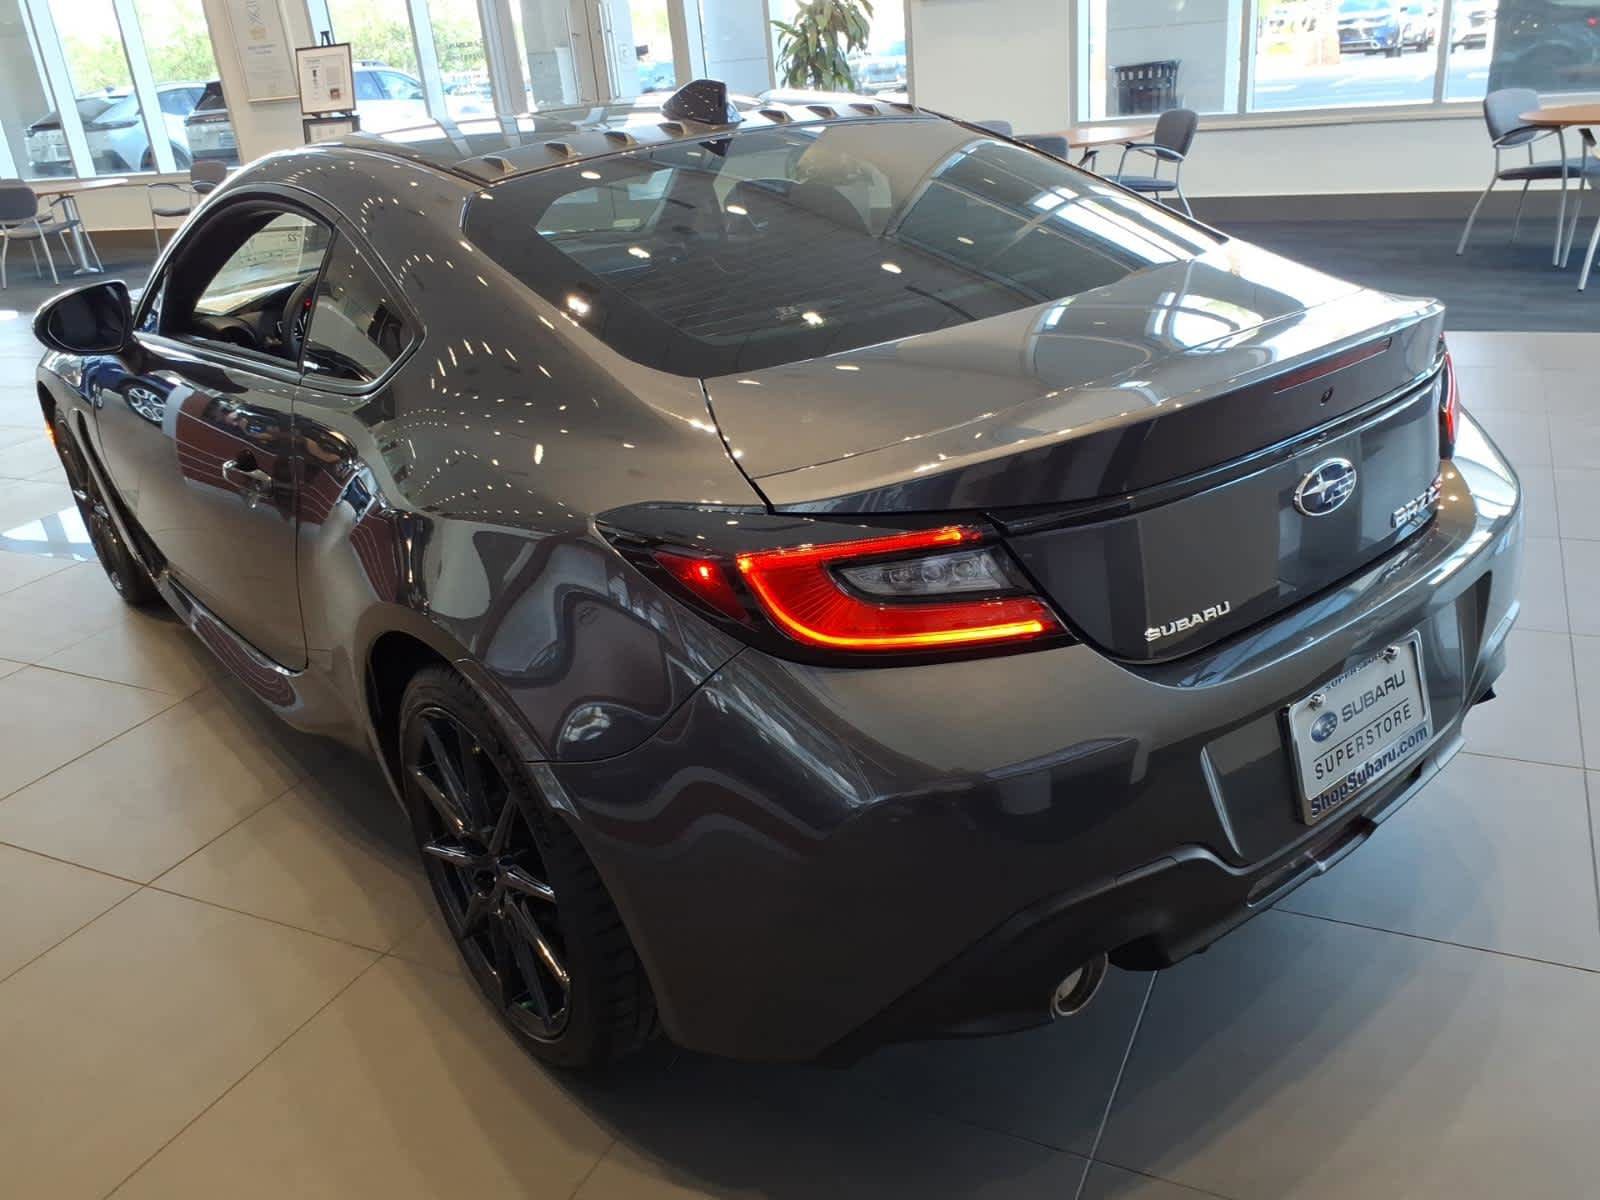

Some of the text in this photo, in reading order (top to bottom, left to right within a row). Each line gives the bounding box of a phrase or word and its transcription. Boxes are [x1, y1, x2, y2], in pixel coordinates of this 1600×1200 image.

[1144, 600, 1231, 642] SUBARU
[1341, 669, 1406, 723] SUBARU
[1311, 726, 1428, 817] ShopSubaru.com
[1314, 703, 1412, 780] SUPERSTORE
